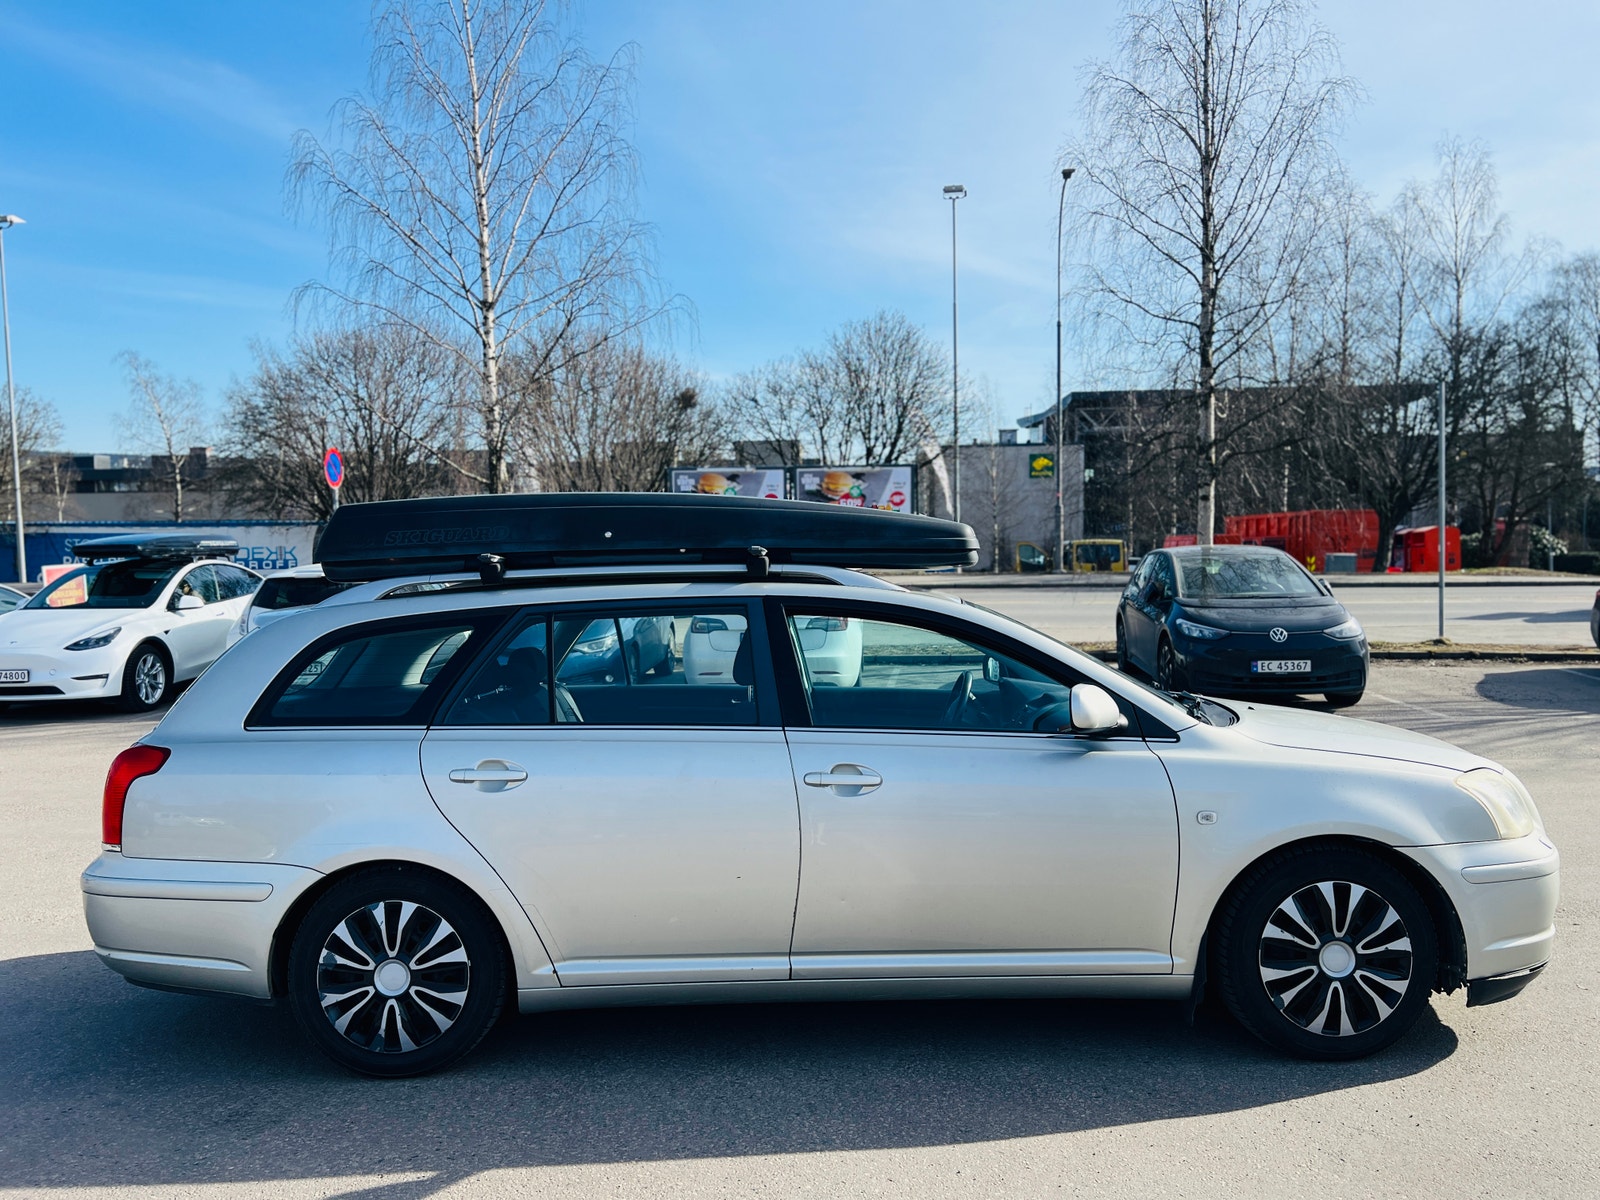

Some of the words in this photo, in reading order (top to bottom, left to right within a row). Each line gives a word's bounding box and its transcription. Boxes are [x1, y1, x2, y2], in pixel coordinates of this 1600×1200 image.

[384, 526, 509, 546] SKIGUARD
[1261, 662, 1273, 671] EC
[1277, 662, 1308, 671] 45367
